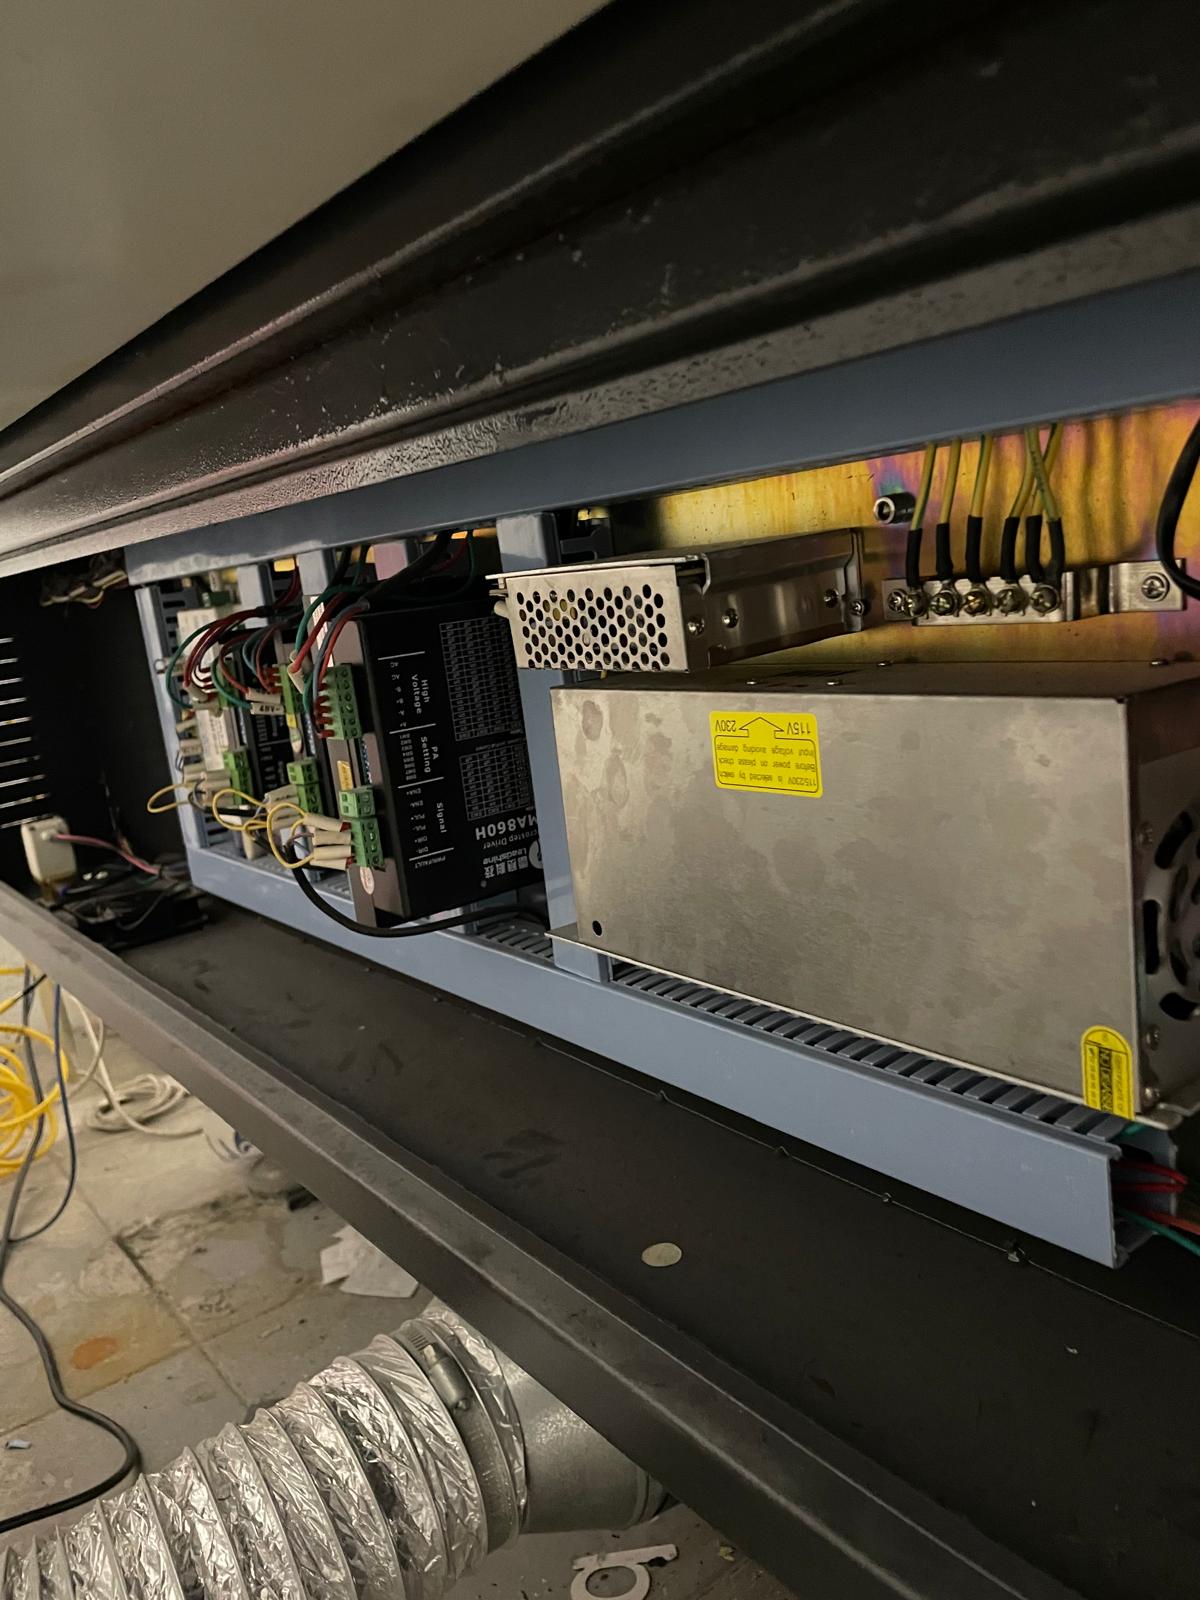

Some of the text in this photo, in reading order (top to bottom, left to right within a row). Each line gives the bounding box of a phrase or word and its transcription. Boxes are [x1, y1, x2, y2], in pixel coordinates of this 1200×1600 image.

[411, 674, 422, 715] Voltage
[421, 679, 430, 703] High
[715, 720, 811, 735] 115V 230V
[420, 736, 431, 773] Setting
[431, 746, 439, 760] PA
[771, 745, 793, 755] voltage
[772, 761, 791, 769] power
[795, 763, 816, 772] Before
[739, 770, 746, 779] by
[436, 802, 447, 833] Signal
[483, 829, 537, 850] crostep Driver
[483, 848, 527, 865] Leadshine
